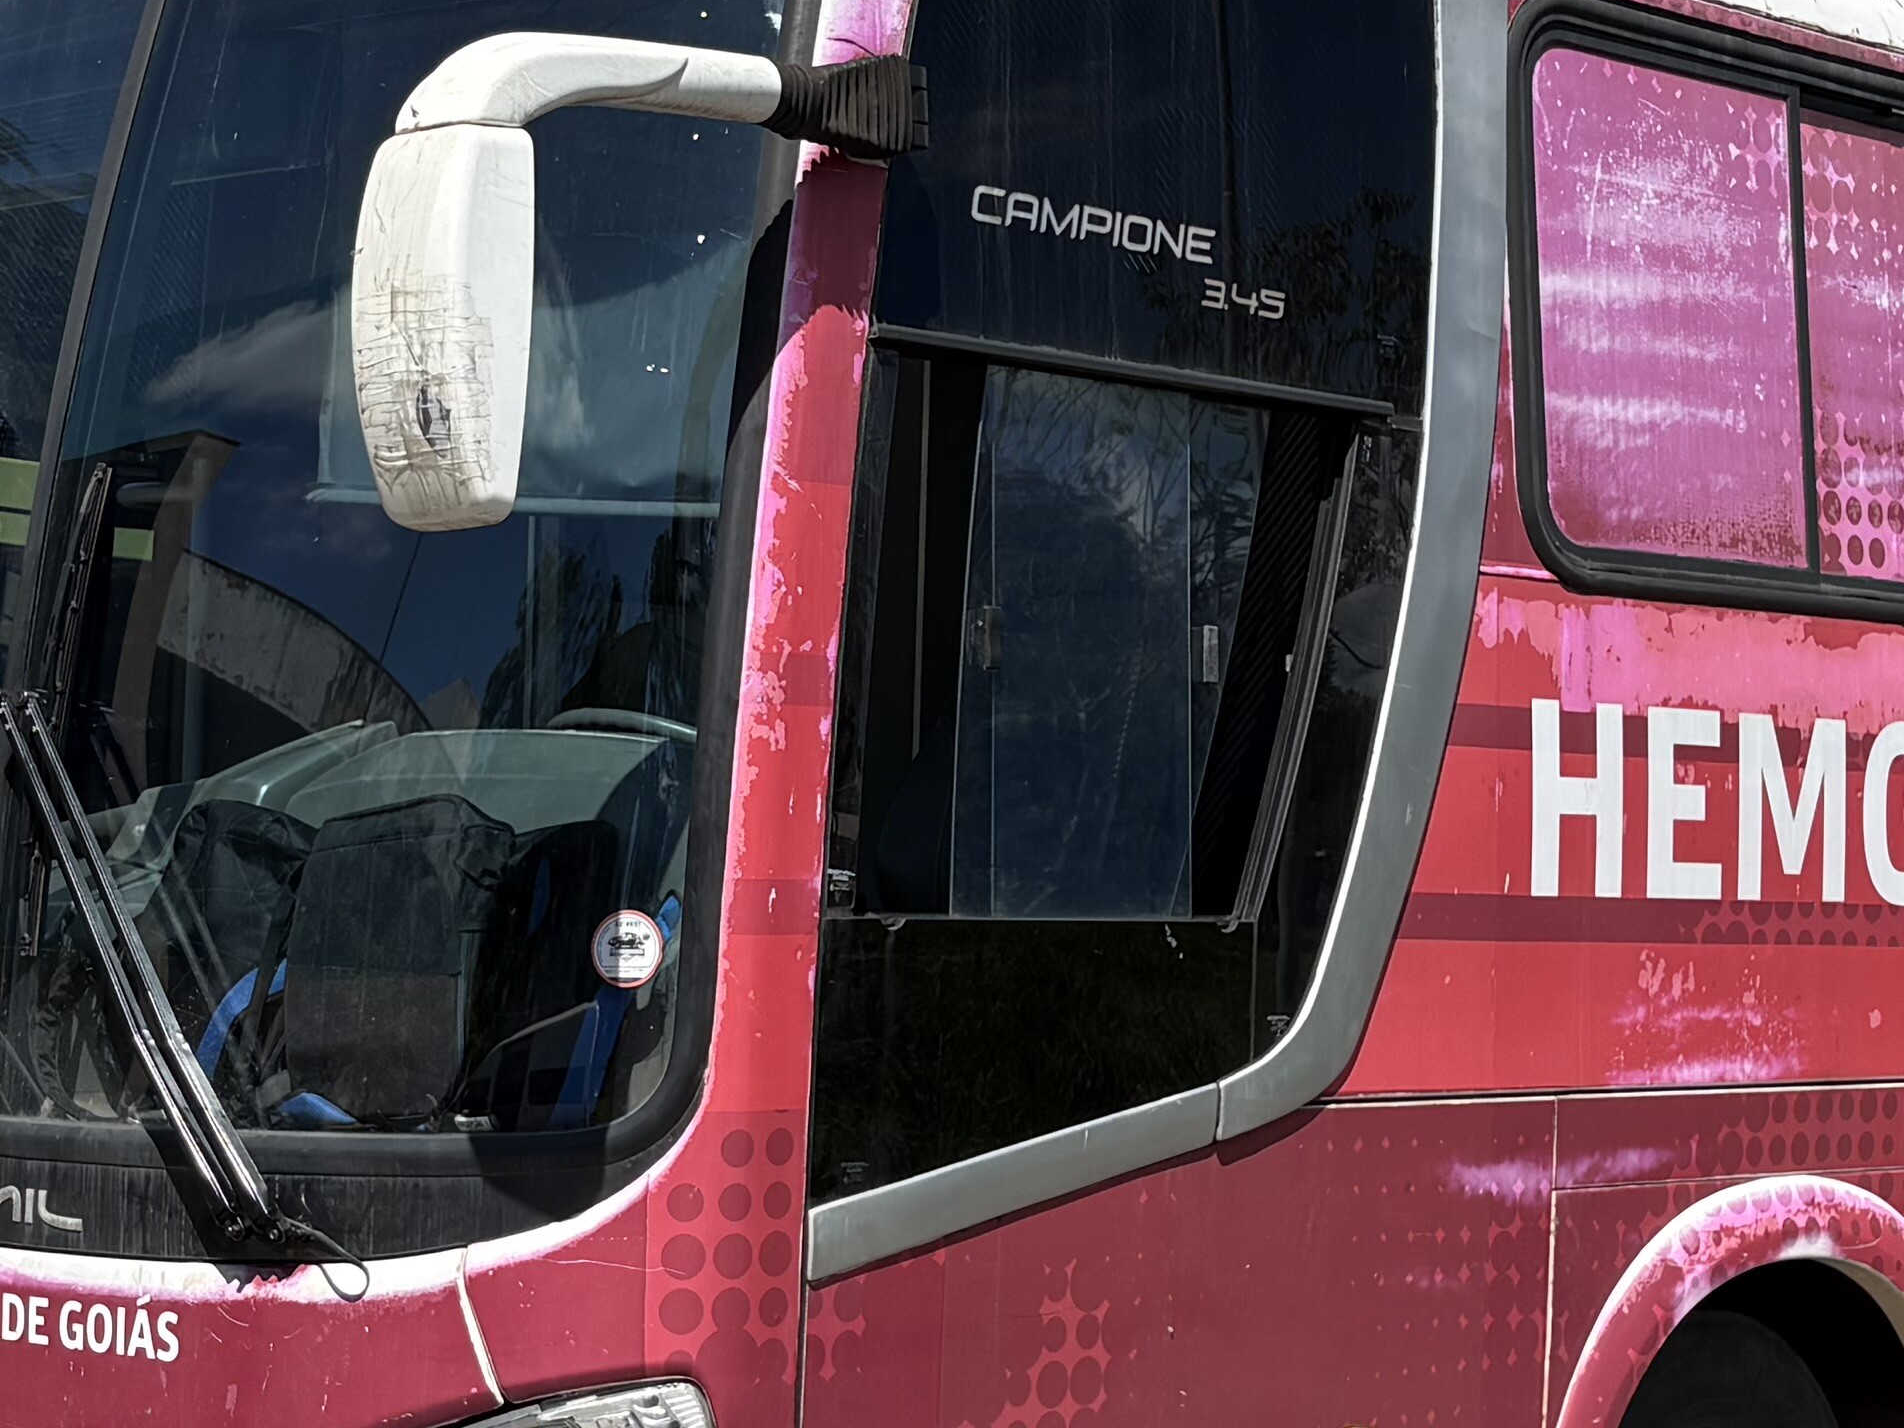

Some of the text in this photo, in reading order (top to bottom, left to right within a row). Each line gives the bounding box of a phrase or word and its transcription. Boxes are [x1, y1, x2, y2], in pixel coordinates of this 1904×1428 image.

[971, 184, 1217, 265] CAMPIONE
[1200, 278, 1286, 320] 3.45
[1, 1292, 50, 1346] DE
[59, 1293, 180, 1363] GOIÁS
